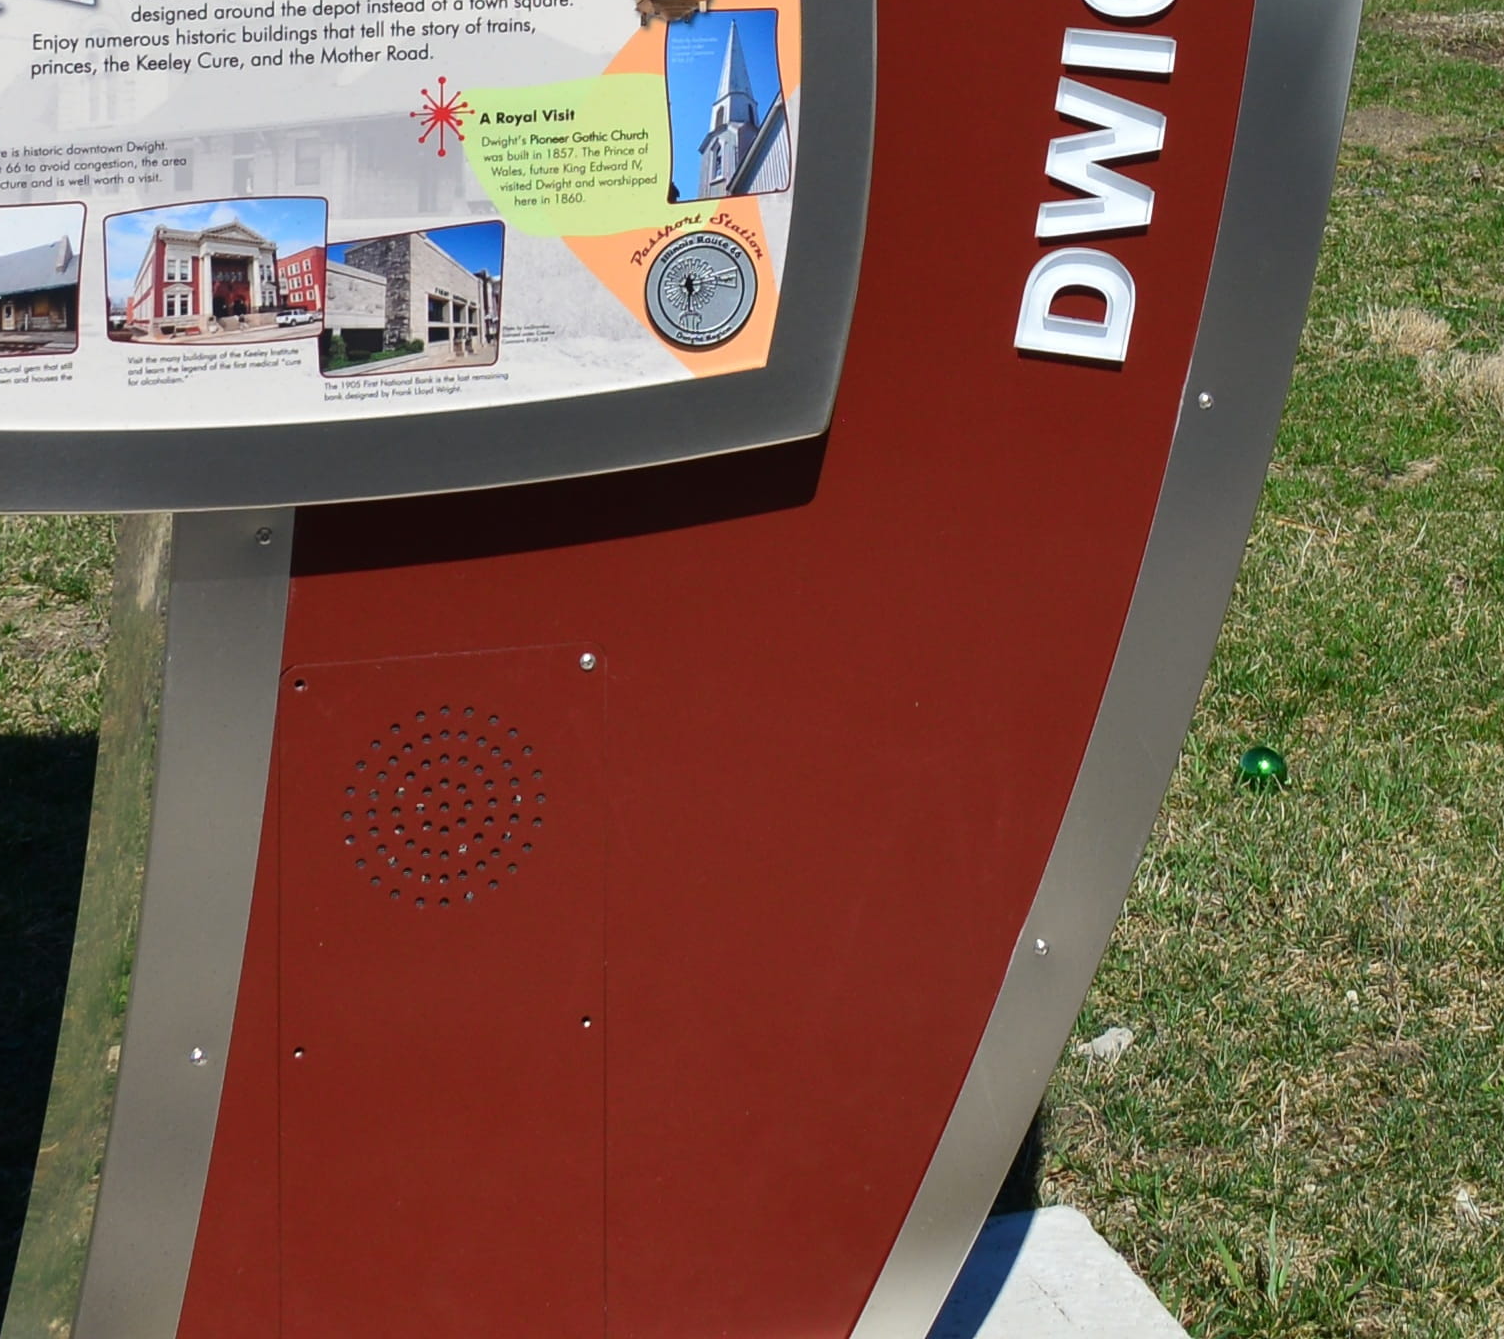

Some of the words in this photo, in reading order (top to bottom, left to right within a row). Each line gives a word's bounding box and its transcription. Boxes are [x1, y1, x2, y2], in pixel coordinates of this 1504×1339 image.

[479, 112, 491, 125] A
[496, 109, 537, 127] Royal
[542, 108, 575, 121] Visit
[481, 135, 526, 149] Dwight's
[529, 133, 570, 145] Pioneer
[571, 130, 608, 143] Gothic
[610, 127, 648, 141] Church
[630, 213, 702, 266] Passport
[709, 213, 764, 261] Station
